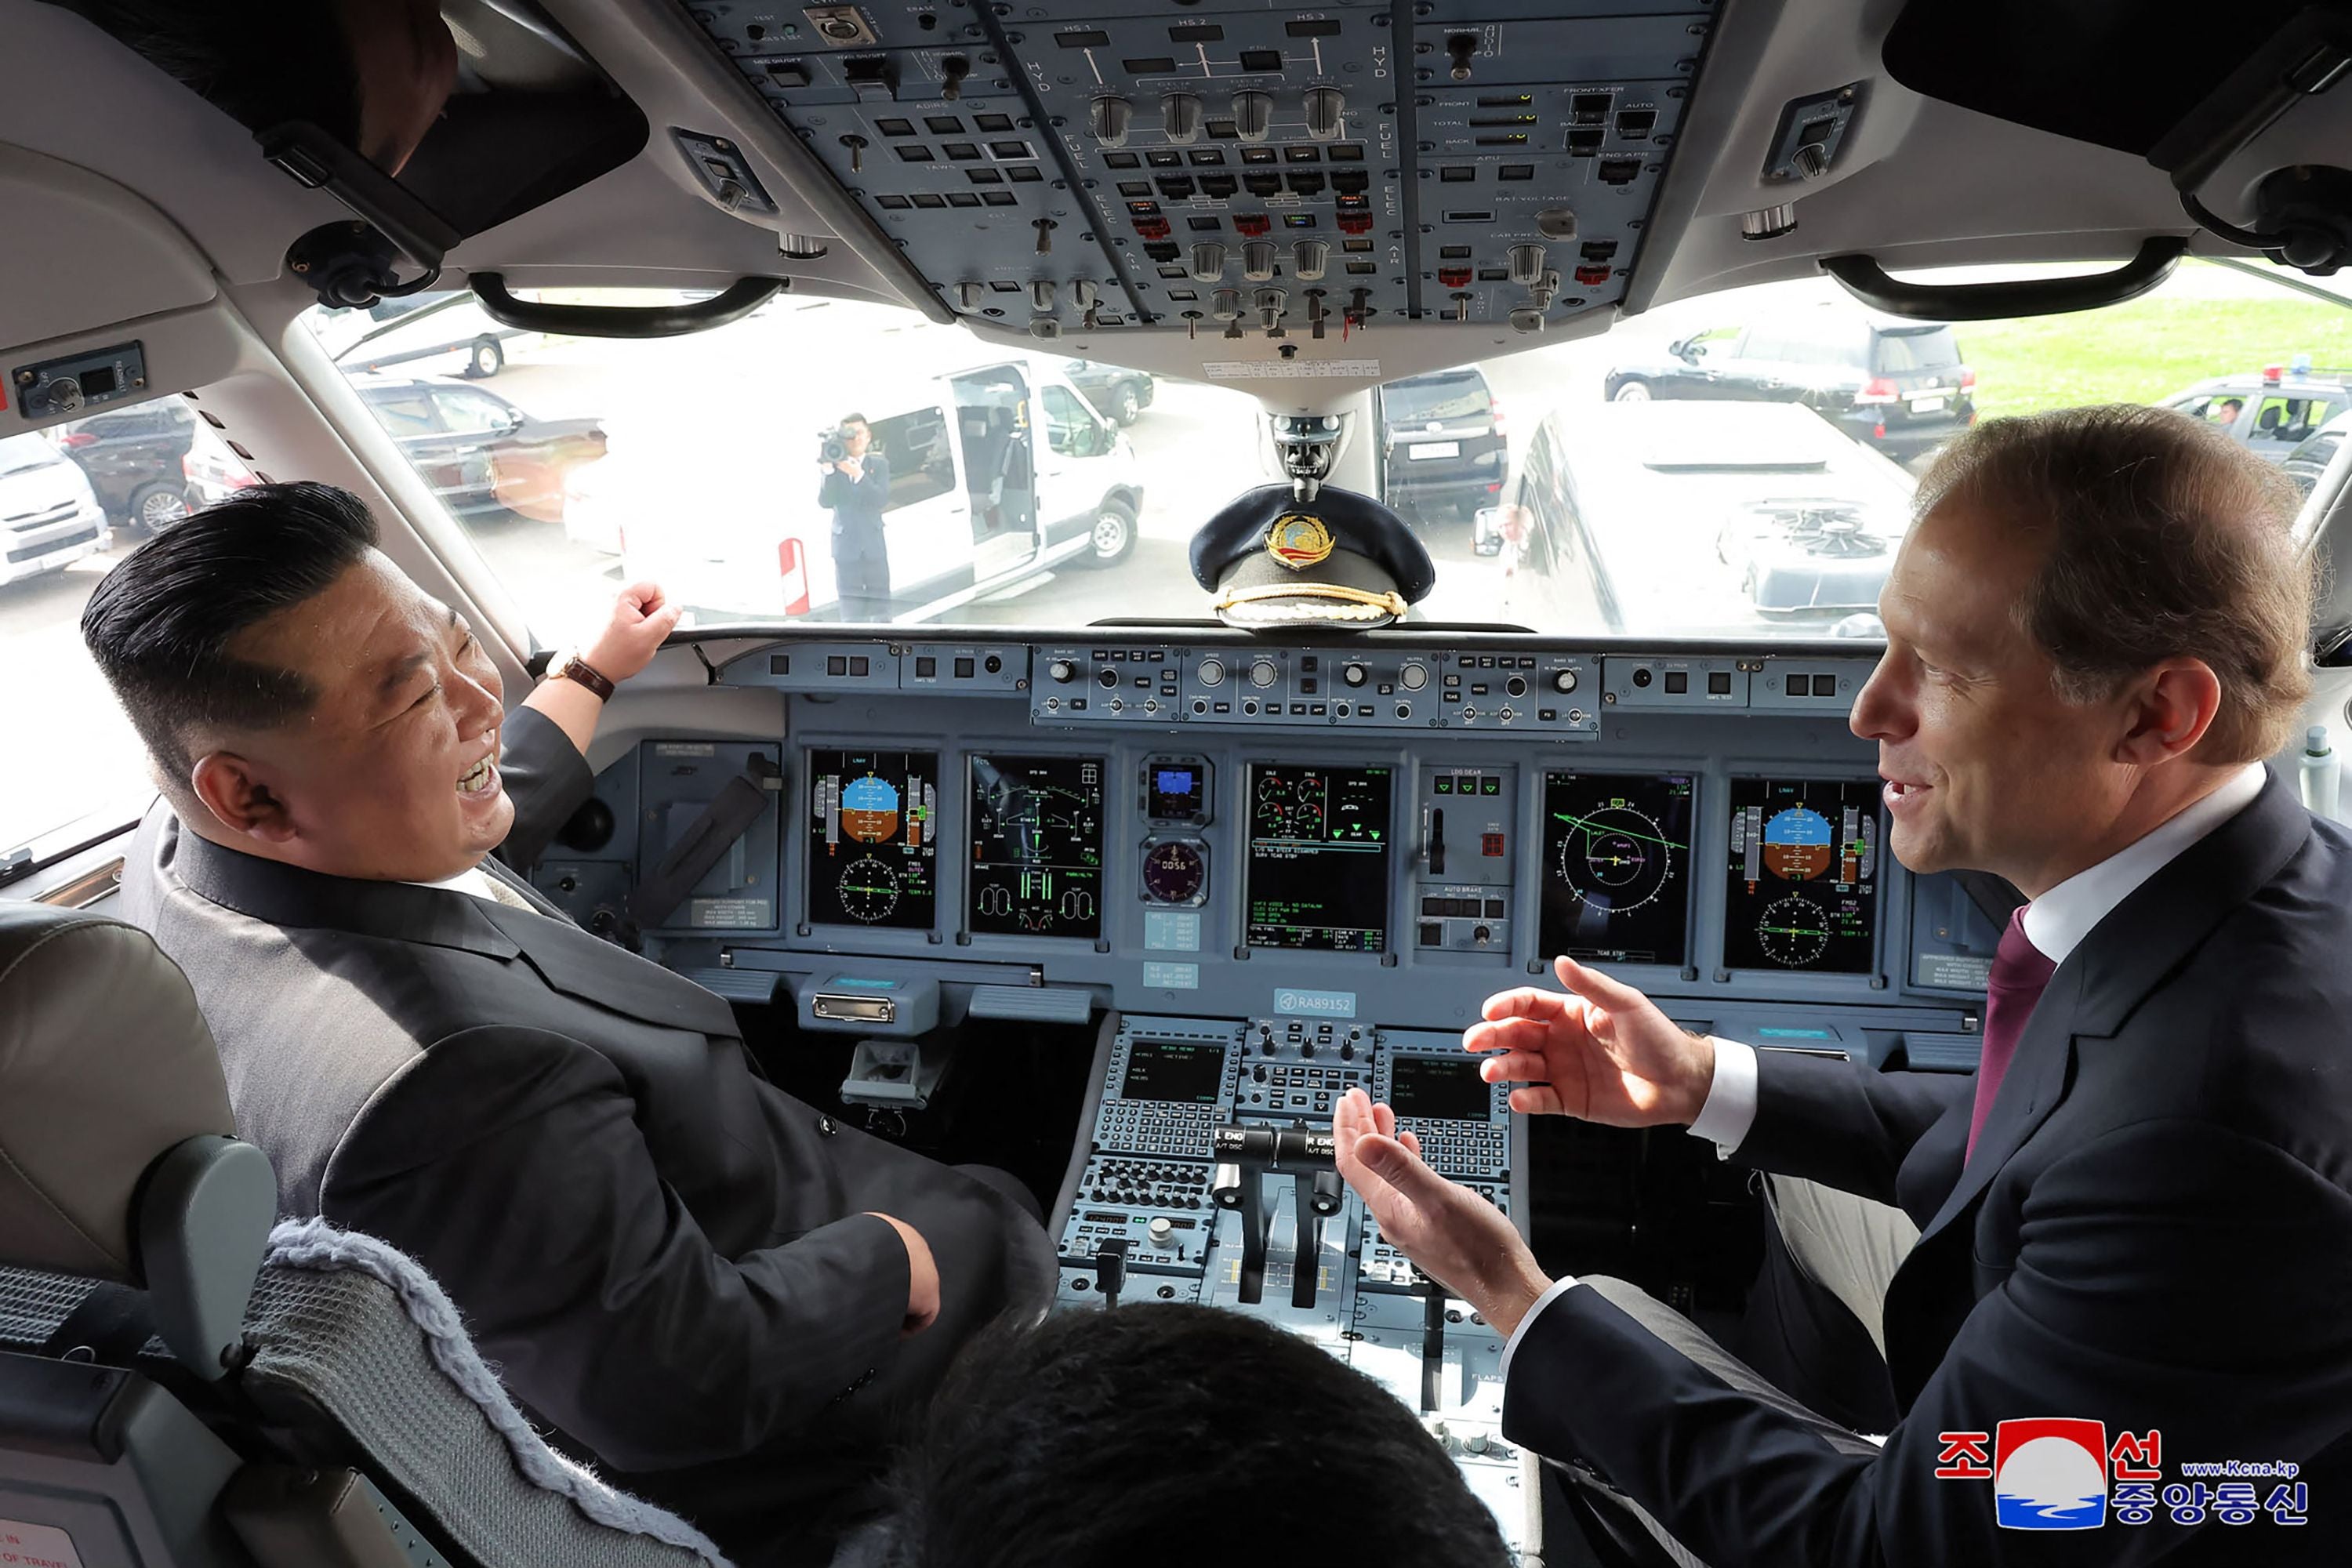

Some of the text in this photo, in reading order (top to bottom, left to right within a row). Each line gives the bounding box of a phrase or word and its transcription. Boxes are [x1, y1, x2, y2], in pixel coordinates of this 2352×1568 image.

[1162, 861, 1185, 869] 0056
[1299, 997, 1350, 1011] RA89152
[1225, 1131, 1243, 1140] ENG
[1471, 1373, 1504, 1382] FLAPS
